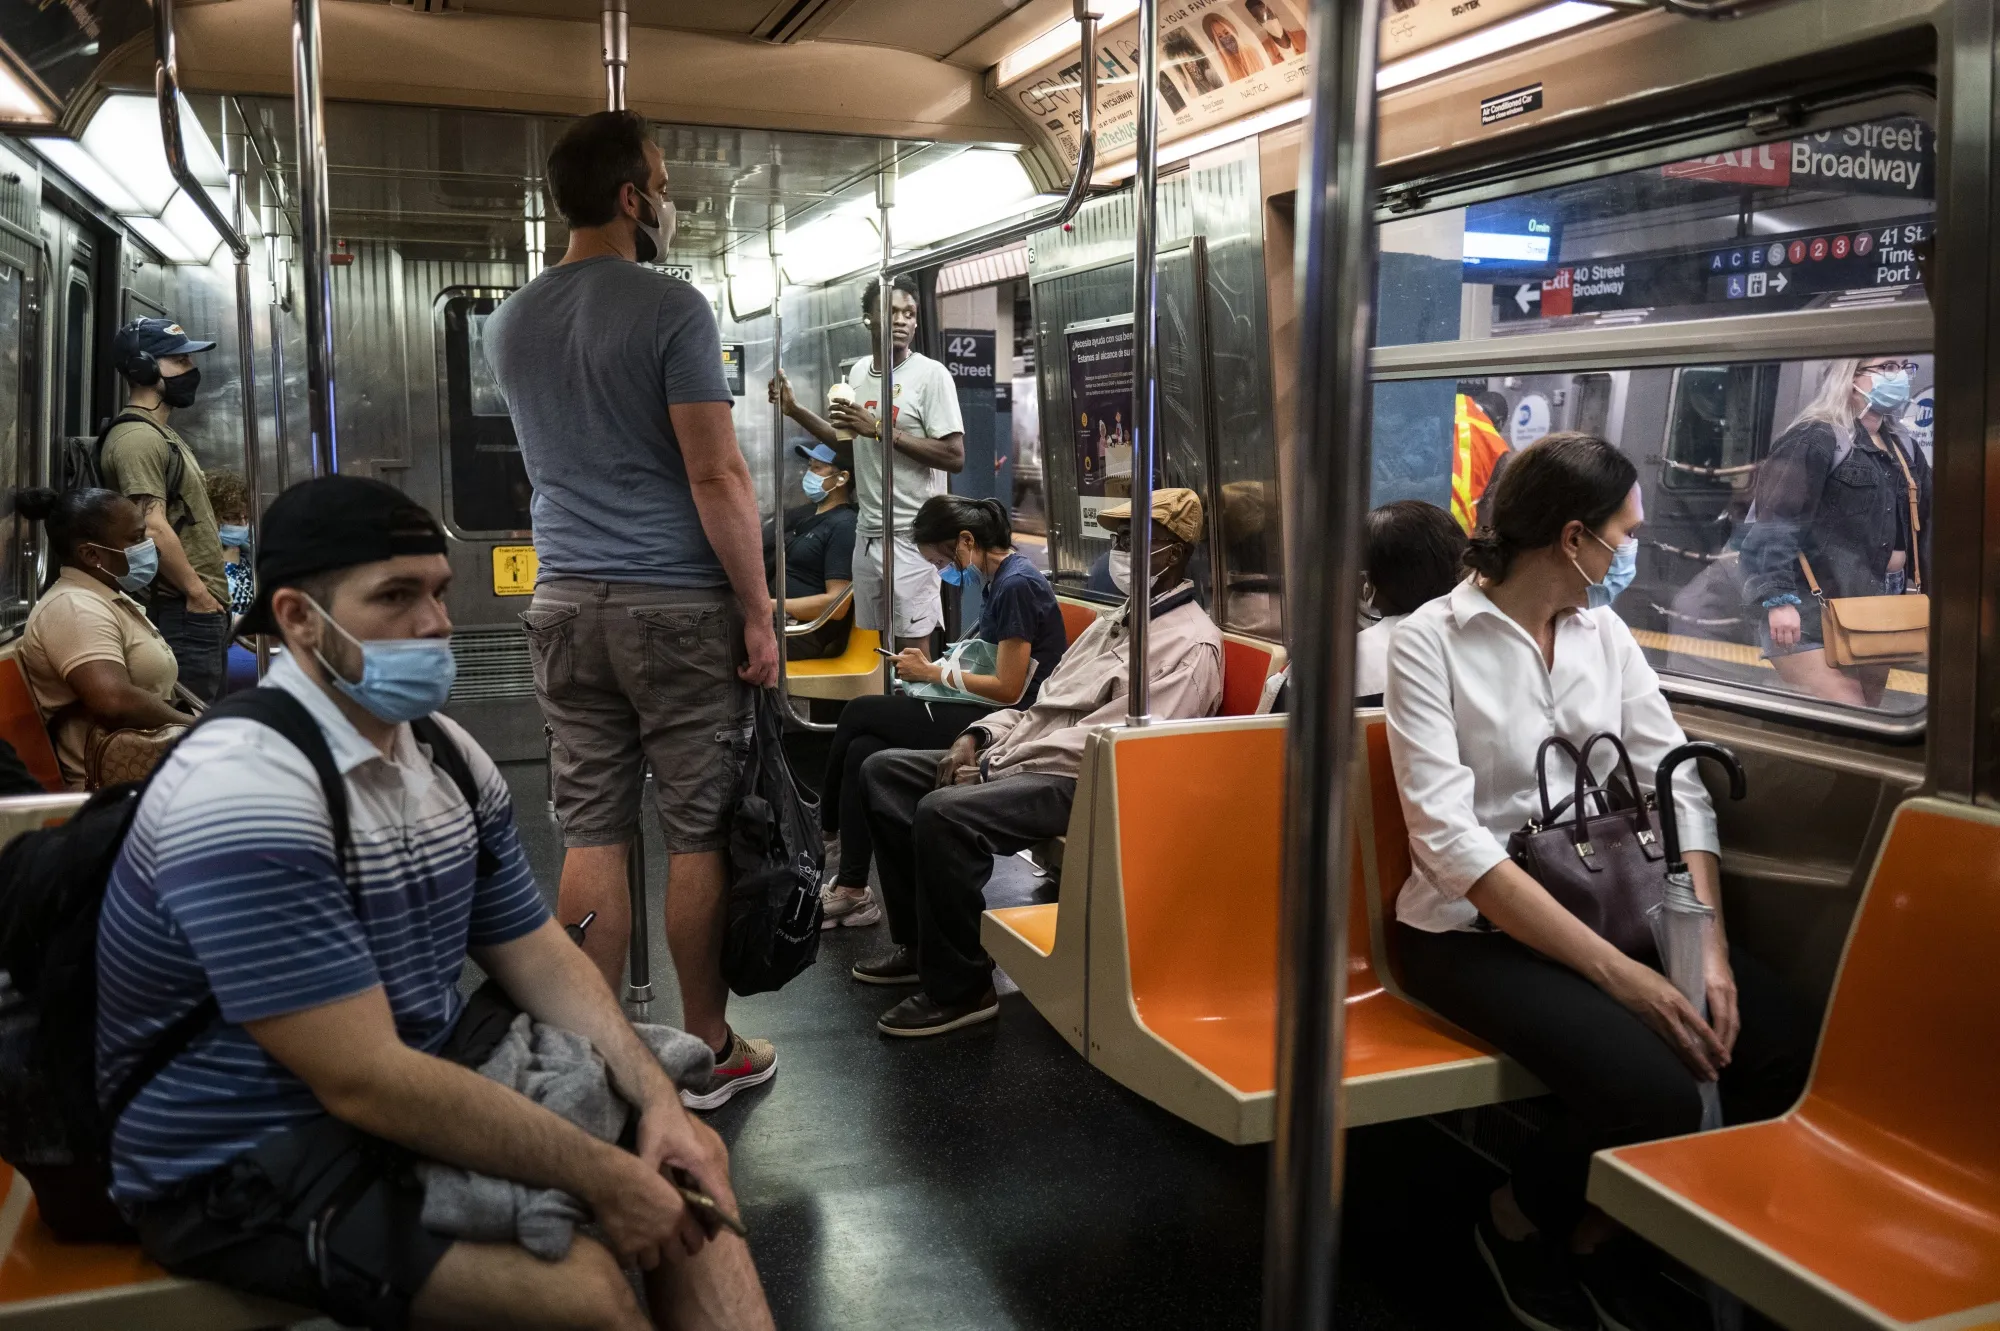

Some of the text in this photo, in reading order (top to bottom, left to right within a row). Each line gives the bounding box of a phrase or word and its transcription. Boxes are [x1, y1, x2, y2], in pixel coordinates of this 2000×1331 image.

[1163, 9, 1189, 25] YOUR
[1101, 89, 1135, 111] NYCSUBWAY
[1482, 95, 1533, 117] Air Conditioned Car
[1843, 120, 1922, 153] Street
[1690, 141, 1775, 171] xit
[1791, 142, 1921, 190] Broadway
[1879, 226, 1926, 246] 41 St.
[1712, 257, 1722, 269] A
[1731, 253, 1741, 266] C
[1751, 251, 1760, 264] E
[1793, 246, 1800, 259] 1
[1814, 243, 1823, 257] 2
[1836, 240, 1846, 254] 3
[1859, 237, 1868, 251] 7
[1573, 269, 1589, 283] 40
[1591, 263, 1625, 281] Street
[1876, 266, 1911, 283] Port
[1573, 280, 1625, 298] Broadway
[948, 337, 977, 358] 42
[1092, 336, 1106, 347] ayuda
[1106, 335, 1115, 344] con
[1115, 334, 1123, 342] sus
[1095, 351, 1100, 361] al
[1100, 350, 1118, 360] alcance
[1117, 348, 1123, 358] de
[1123, 349, 1131, 357] su
[948, 362, 992, 377] Street
